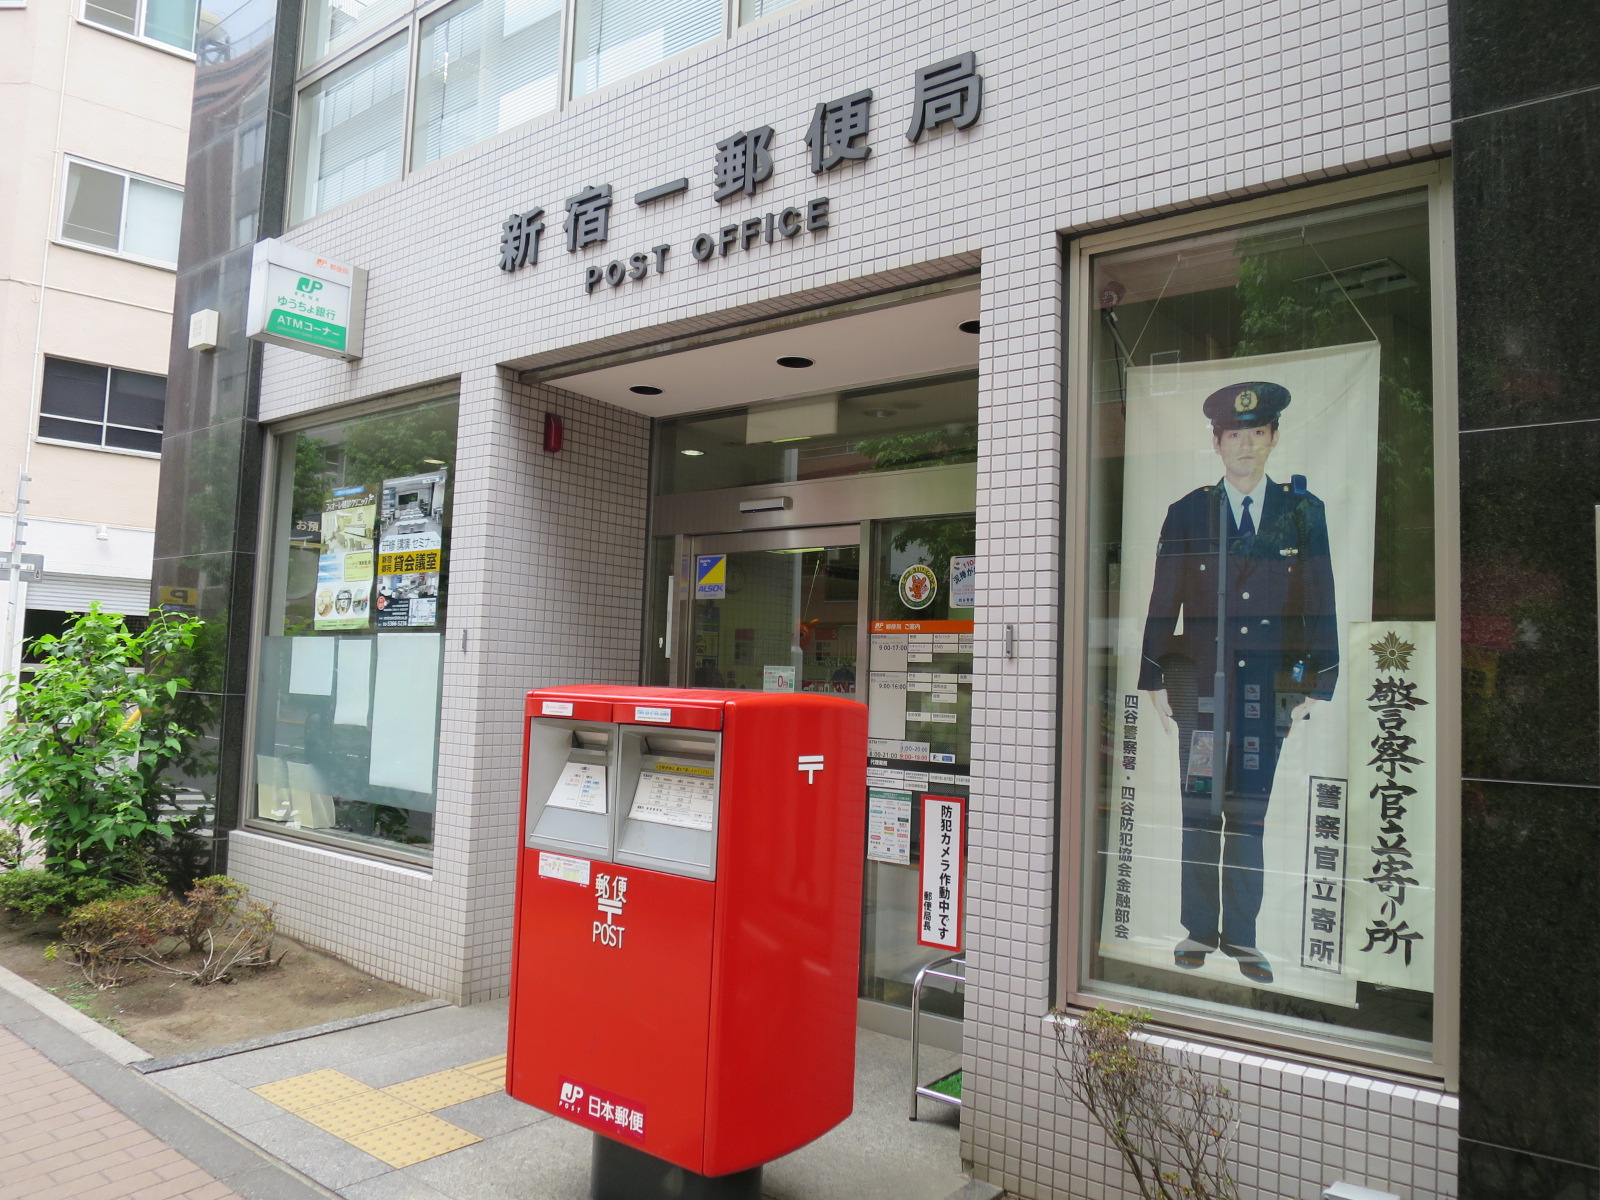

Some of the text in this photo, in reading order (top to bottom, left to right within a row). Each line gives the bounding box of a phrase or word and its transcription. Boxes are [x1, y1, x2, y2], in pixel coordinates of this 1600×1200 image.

[499, 51, 983, 272] 新宿一郵便局
[585, 196, 830, 294] POST OFFICE
[277, 295, 336, 320] ゆうちょ銀行
[277, 315, 340, 337] ATMコーナー
[296, 520, 322, 533] お預
[394, 552, 437, 573] 貸会議室
[953, 566, 975, 584] 泥棒が
[697, 584, 724, 593] ALSOK
[1114, 694, 1139, 941] 四谷警察署・四谷防犯協会金融部会
[1360, 675, 1429, 967] 警察官立寄り所
[595, 872, 628, 903] 郵便
[938, 804, 953, 941] 防犯カメラ作動中です
[1310, 783, 1341, 966] 警察官立寄所
[923, 890, 933, 932] 郵便局長
[592, 920, 625, 949] POST
[558, 1101, 582, 1114] POST
[588, 1094, 644, 1134] 日本郵便
